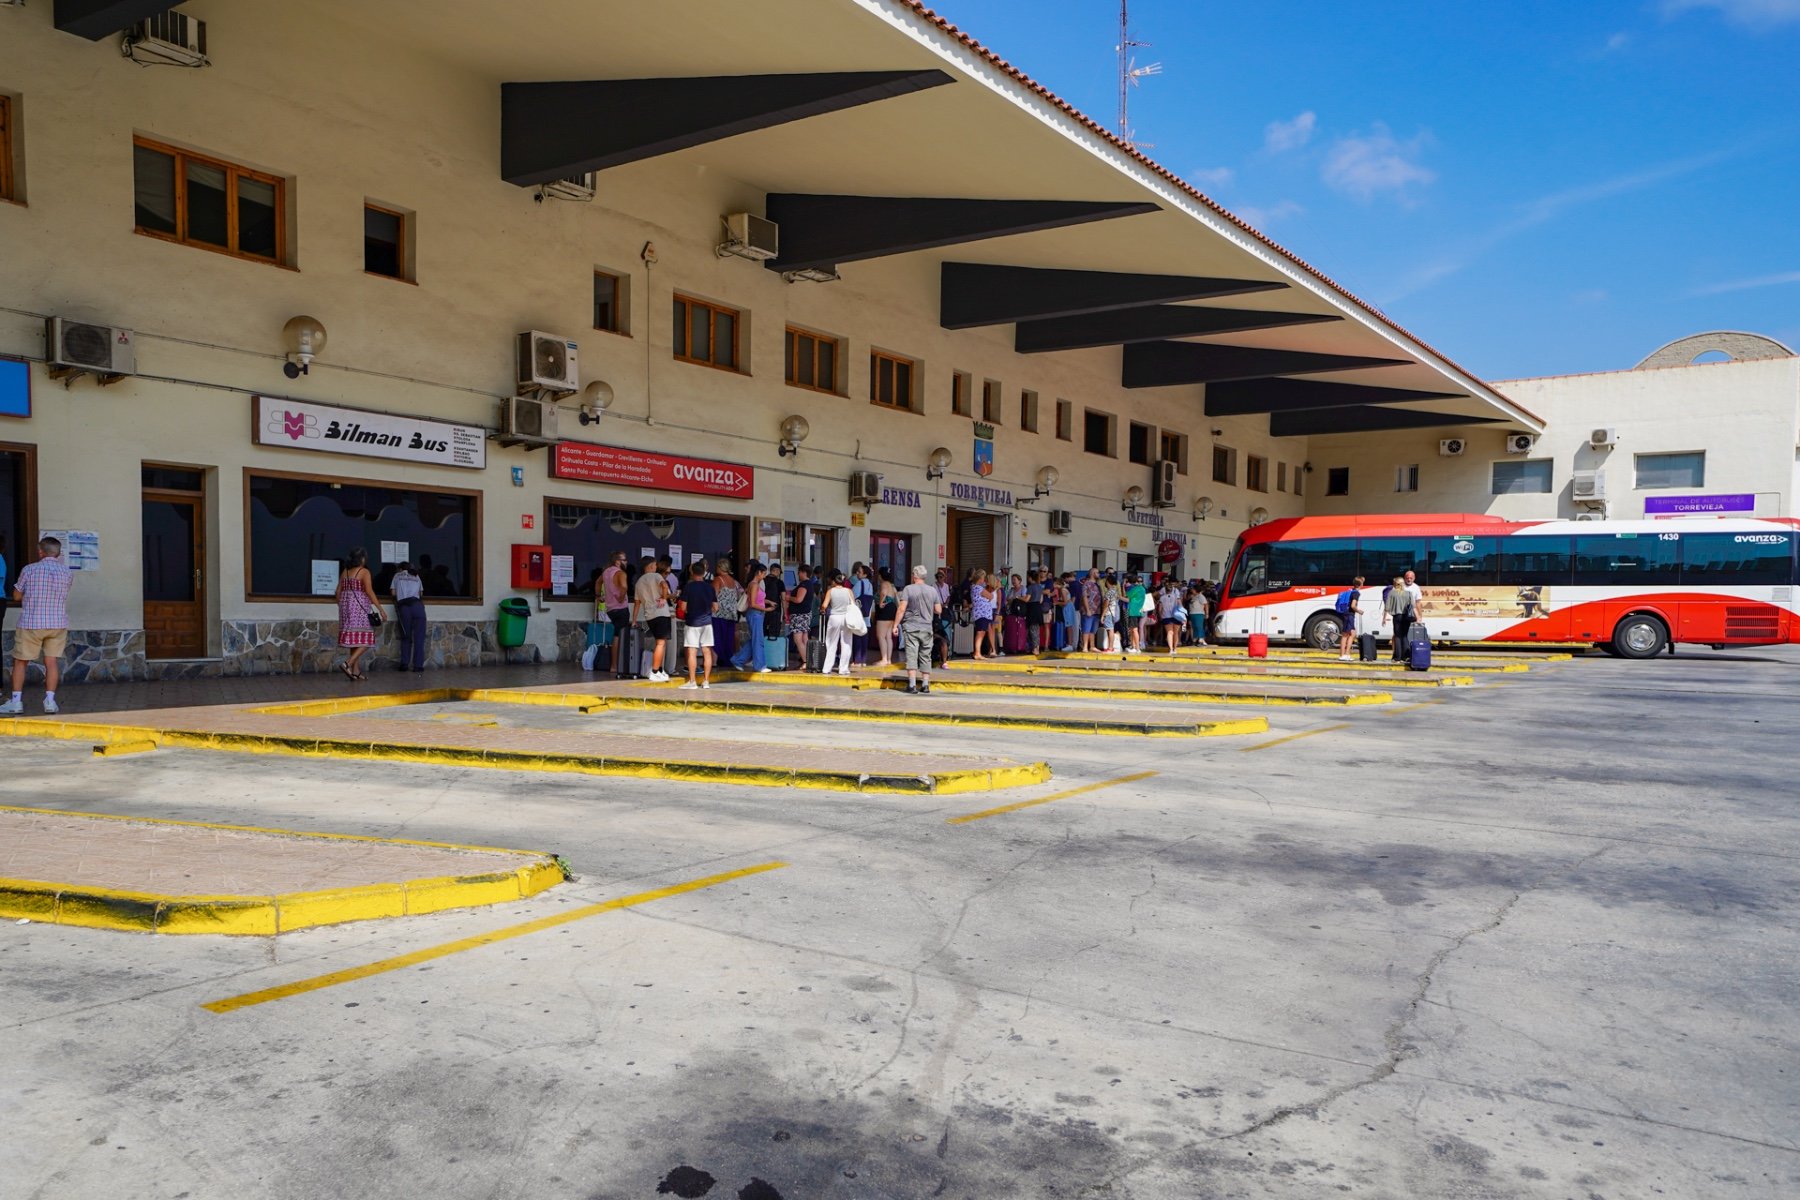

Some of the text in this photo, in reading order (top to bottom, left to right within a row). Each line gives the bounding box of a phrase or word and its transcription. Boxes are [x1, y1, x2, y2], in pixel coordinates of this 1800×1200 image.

[324, 420, 449, 453] Bilman Bus
[561, 447, 582, 455] Alicante
[585, 449, 614, 459] Guardamar
[646, 458, 667, 466] Orihuela
[561, 456, 583, 465] Orihuela
[584, 458, 599, 467] Costa
[602, 461, 614, 469] Pilar
[560, 466, 576, 474] Santa
[577, 467, 589, 475] Pola
[673, 463, 734, 486] avanza
[882, 488, 922, 509] RENSA
[950, 482, 1012, 505] TORREVIEJA
[1658, 533, 1679, 541] 1430
[1734, 535, 1777, 543] avanza
